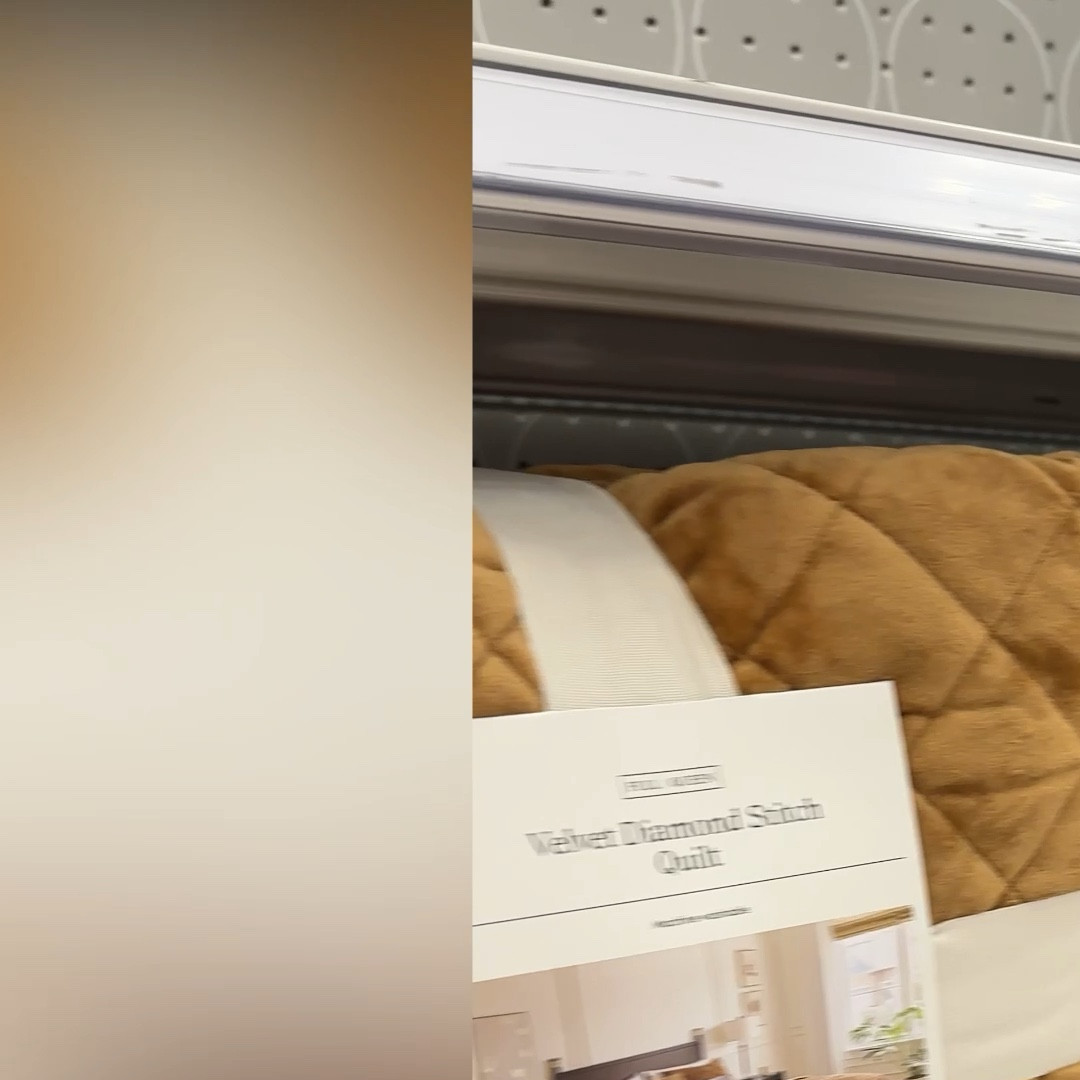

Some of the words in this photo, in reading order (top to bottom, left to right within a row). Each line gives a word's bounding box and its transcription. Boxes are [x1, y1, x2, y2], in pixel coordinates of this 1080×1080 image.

[523, 826, 618, 857] Velvet
[618, 808, 743, 846] Diamond
[745, 799, 825, 829] Stitch
[653, 846, 725, 875] Quilt
